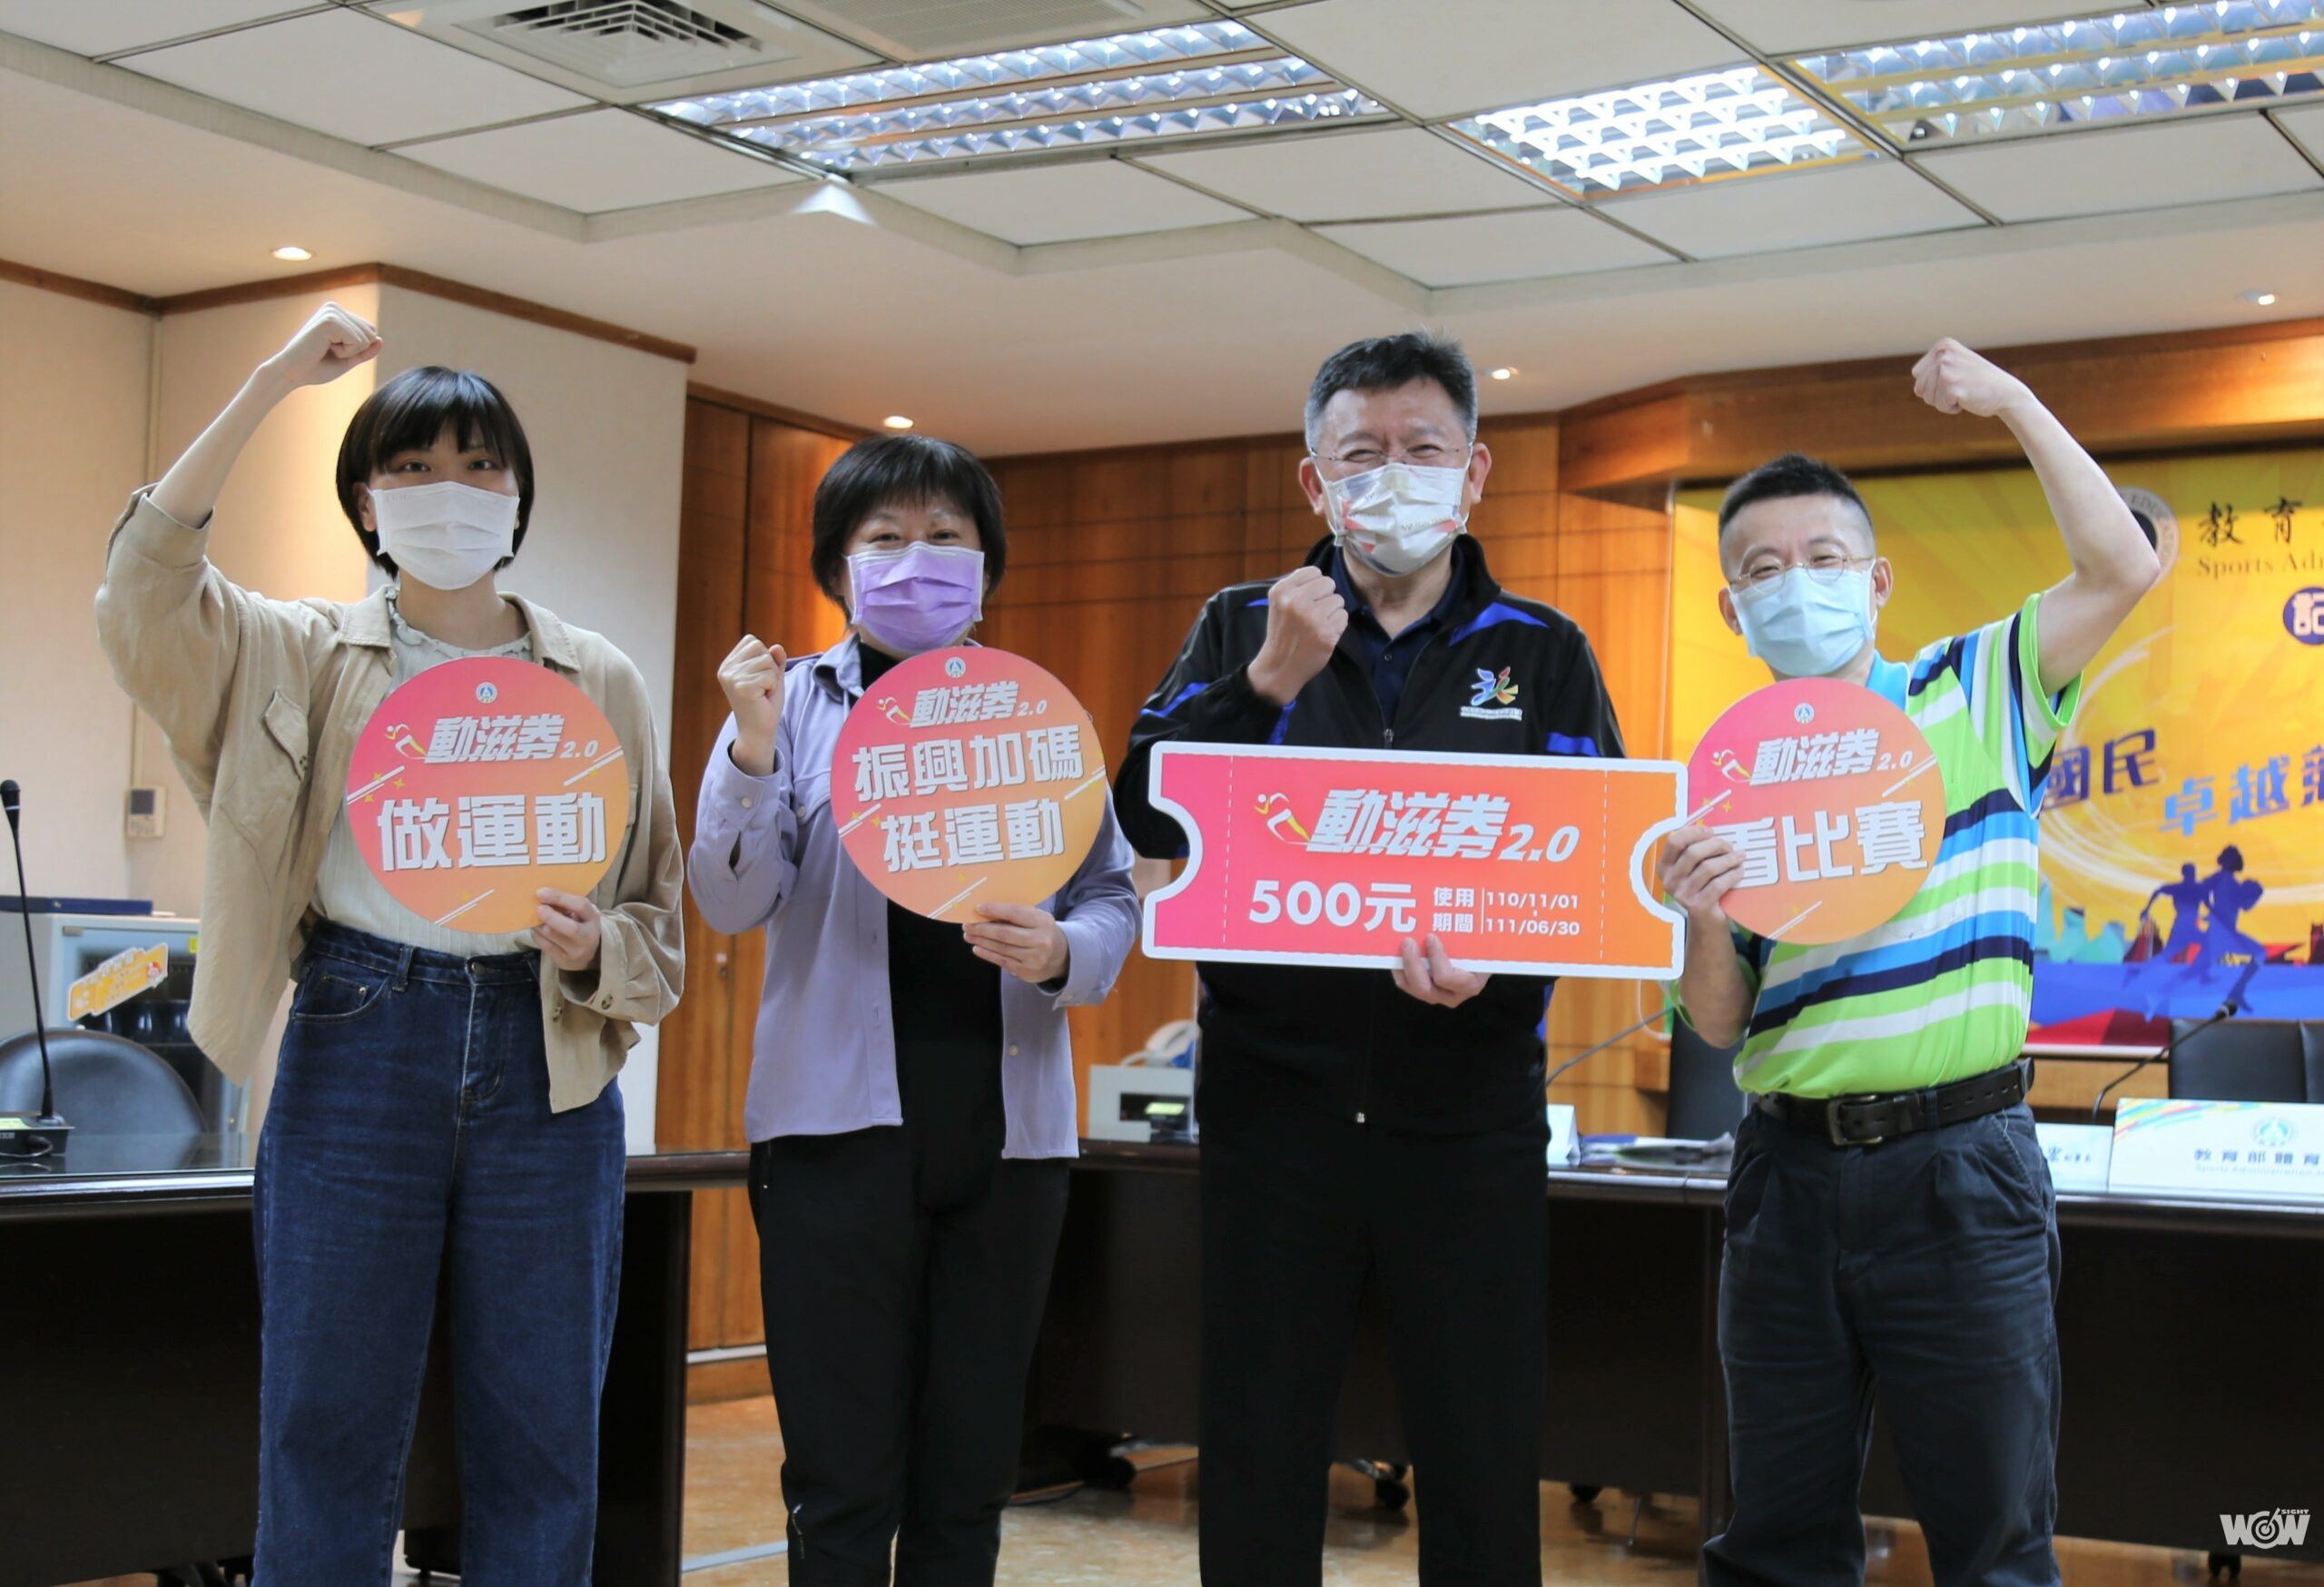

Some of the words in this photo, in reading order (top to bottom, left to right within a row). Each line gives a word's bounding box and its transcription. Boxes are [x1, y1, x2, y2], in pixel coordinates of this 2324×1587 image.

[2198, 497, 2324, 547] 教育
[2283, 549, 2324, 572] Ad
[852, 724, 1084, 803] 振興加碼
[377, 792, 607, 872] 做運動
[881, 798, 1065, 872] 挺運動
[1248, 880, 1416, 933] 500元
[1433, 886, 1475, 908] 使用
[1486, 892, 1579, 910] 110/11/01
[1433, 912, 1474, 933] 期間
[1486, 918, 1581, 936] 111/06/30
